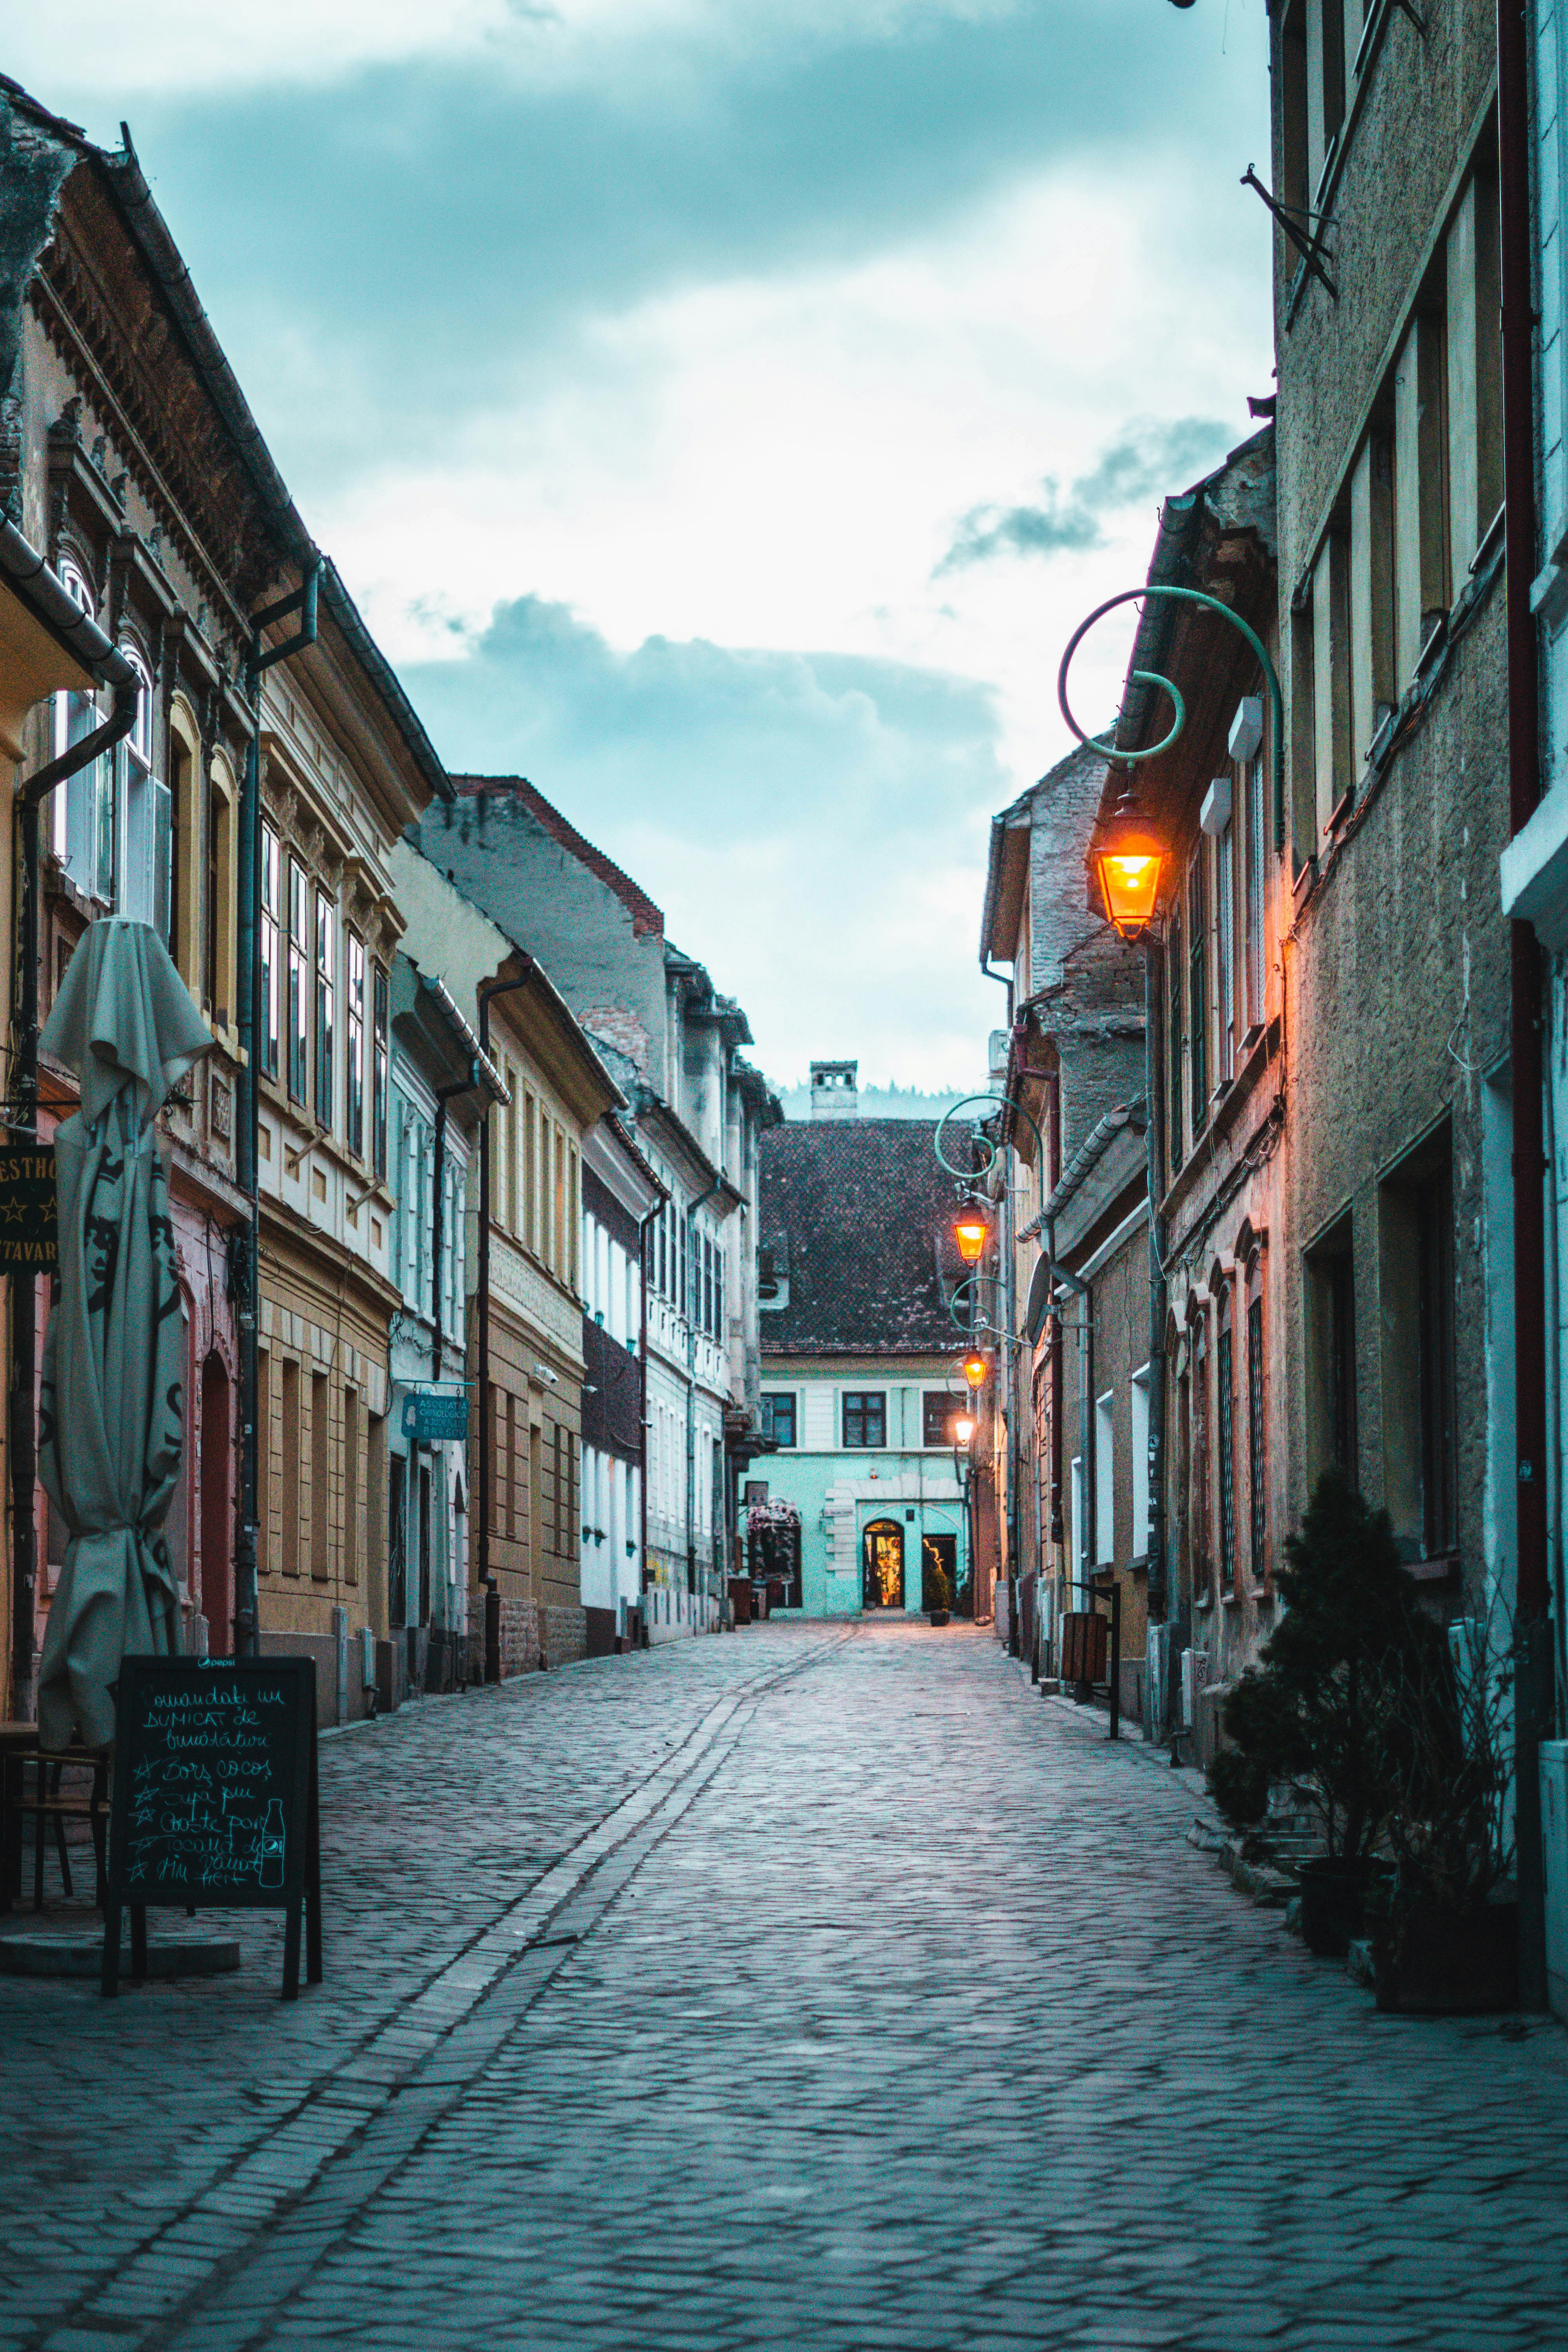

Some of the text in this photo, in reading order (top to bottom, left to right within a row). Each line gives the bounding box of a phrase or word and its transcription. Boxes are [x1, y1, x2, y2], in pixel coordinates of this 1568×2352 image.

[0, 1240, 56, 1261] TAVAR
[211, 1659, 235, 1668] pepsi
[257, 1690, 286, 1705] un
[233, 1708, 261, 1726] de
